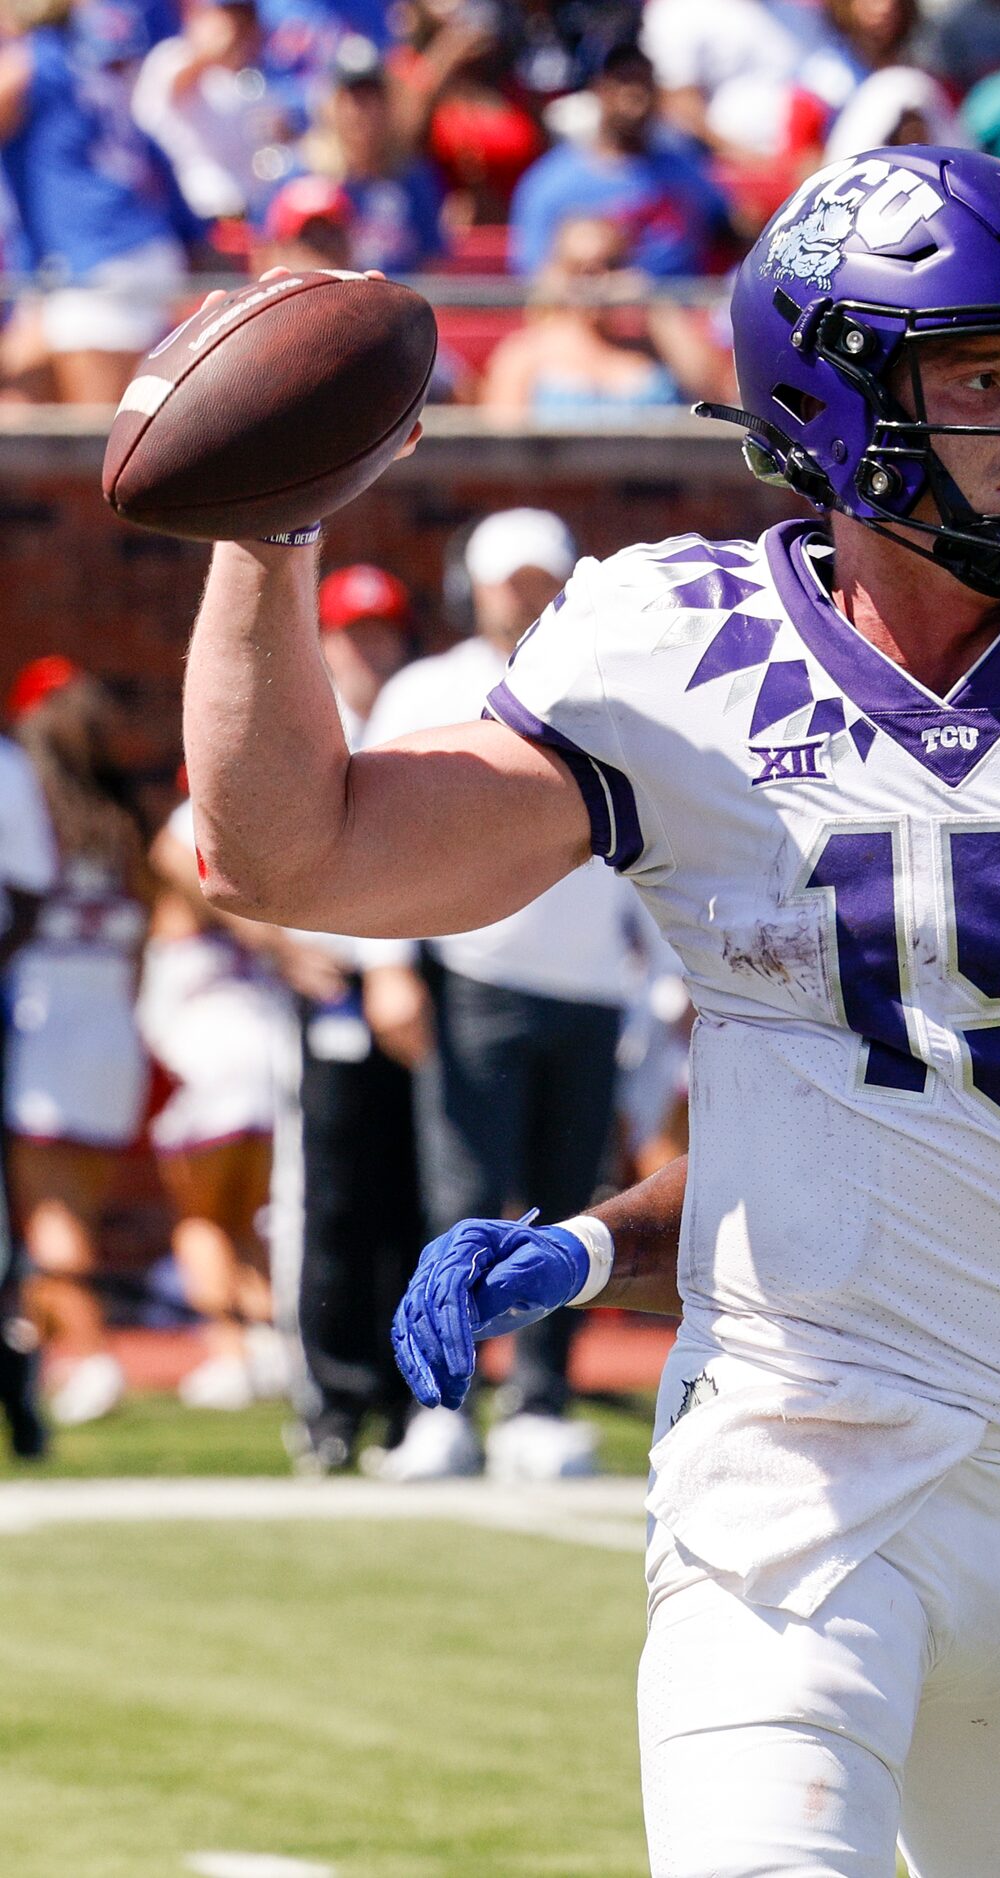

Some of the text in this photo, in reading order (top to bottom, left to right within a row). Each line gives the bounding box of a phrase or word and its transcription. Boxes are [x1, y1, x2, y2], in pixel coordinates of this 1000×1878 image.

[768, 157, 946, 250] TCU
[921, 726, 979, 753] TCU
[749, 741, 826, 786] XII
